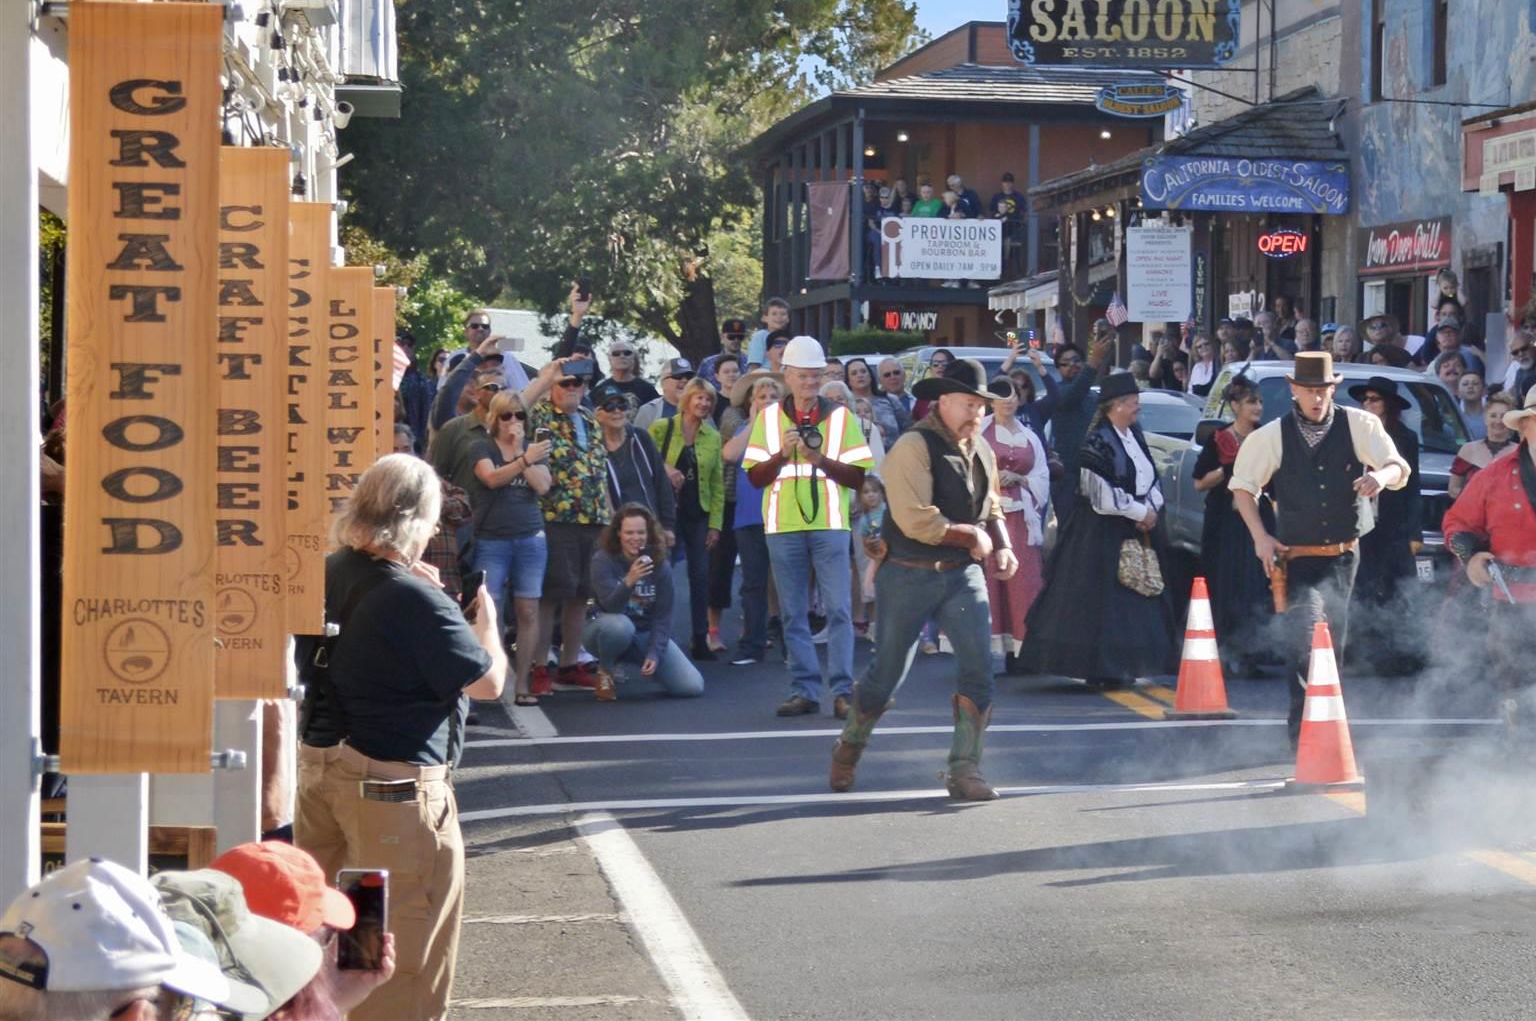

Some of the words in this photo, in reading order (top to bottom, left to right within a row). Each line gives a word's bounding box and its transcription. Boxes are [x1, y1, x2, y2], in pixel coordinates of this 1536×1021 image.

[1062, 47, 1120, 58] EST.
[1127, 47, 1187, 58] 1852
[106, 79, 186, 323] GREAT
[1192, 192, 1246, 207] FAMILIES
[1250, 194, 1303, 209] WELCOME
[911, 224, 997, 241] PROVISIONS
[1413, 221, 1443, 260] Grill
[920, 247, 966, 257] BOURBON
[968, 249, 986, 257] BAR
[927, 239, 971, 249] TAPROOM
[1258, 234, 1307, 253] OPEN
[910, 261, 931, 271] OPEN
[933, 261, 954, 271] DAILY
[217, 205, 265, 381] CRAFT
[886, 312, 899, 329] NO
[901, 312, 938, 330] VACANCY
[327, 299, 361, 410] LOCAL
[102, 362, 184, 556] FOOD
[216, 408, 263, 546] BEER
[96, 688, 178, 705] TAVERN
